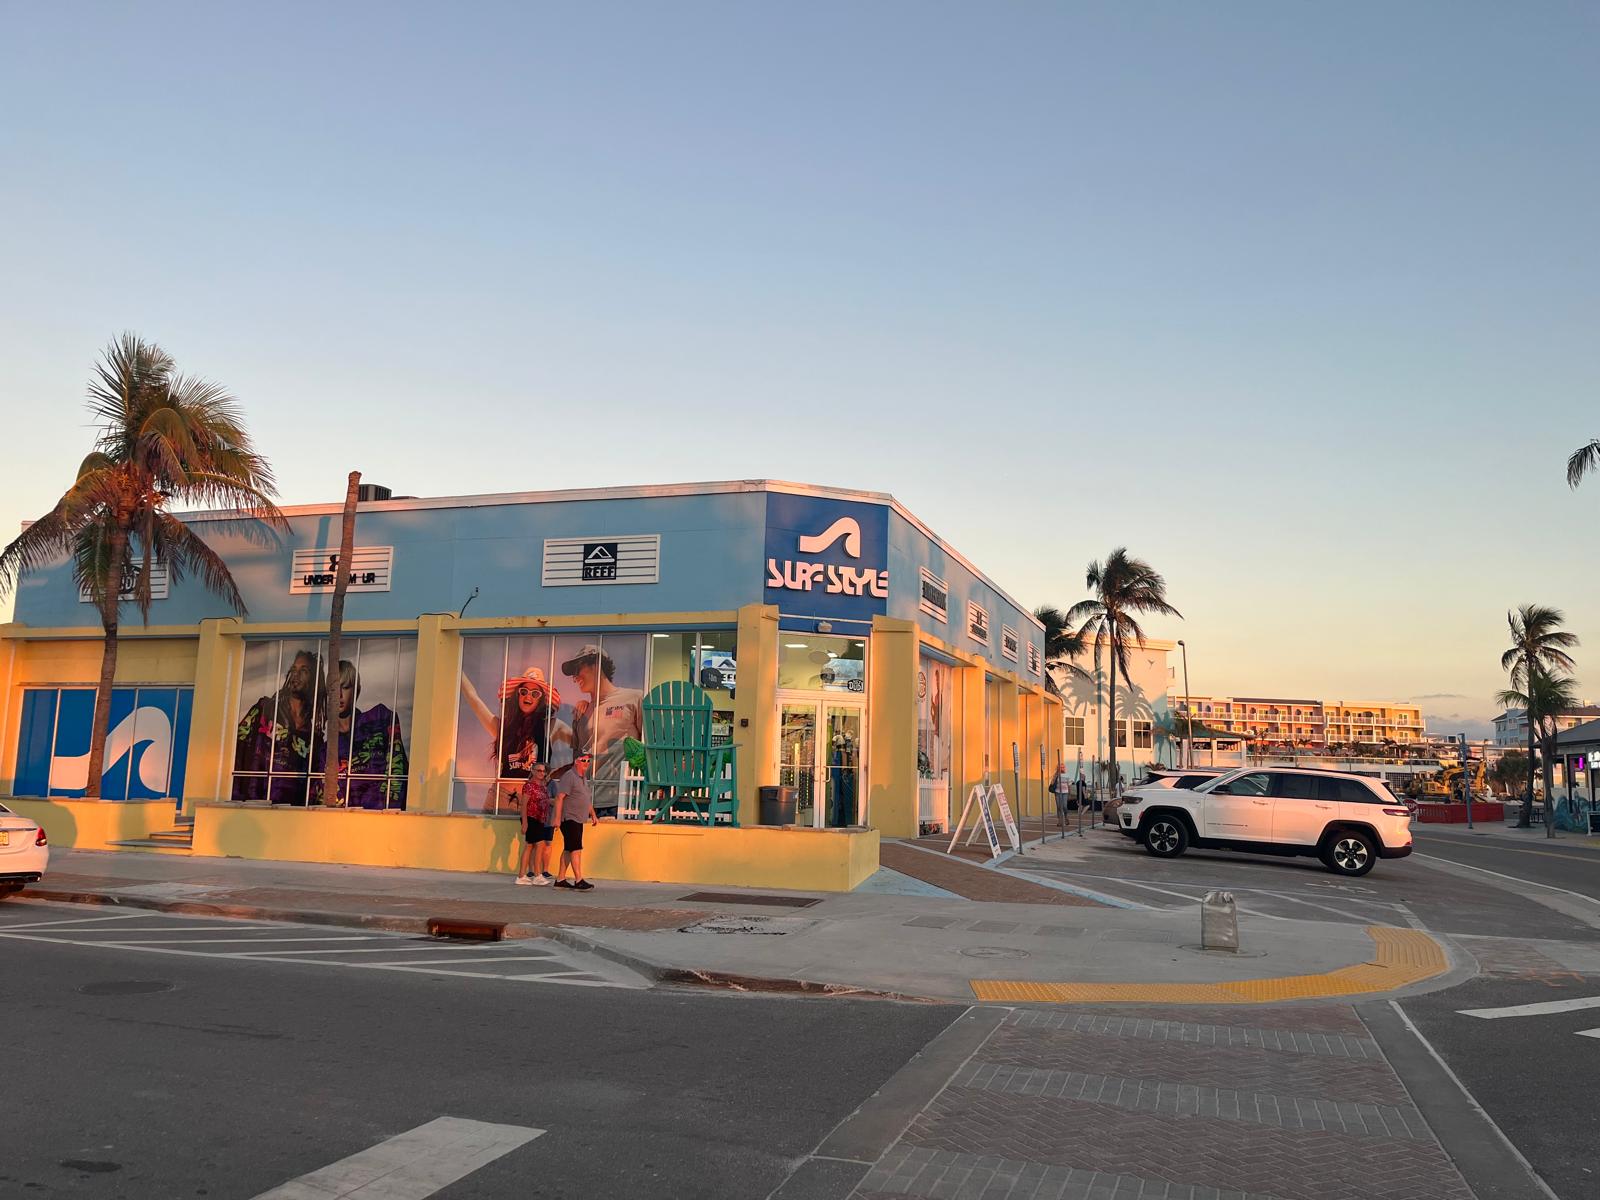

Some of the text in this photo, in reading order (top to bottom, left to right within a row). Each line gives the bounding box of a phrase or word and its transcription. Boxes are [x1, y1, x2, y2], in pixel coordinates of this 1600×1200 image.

[584, 565, 616, 579] REEF
[766, 558, 824, 591] SURF
[825, 564, 889, 599] STYLE
[303, 574, 333, 585] UNDER
